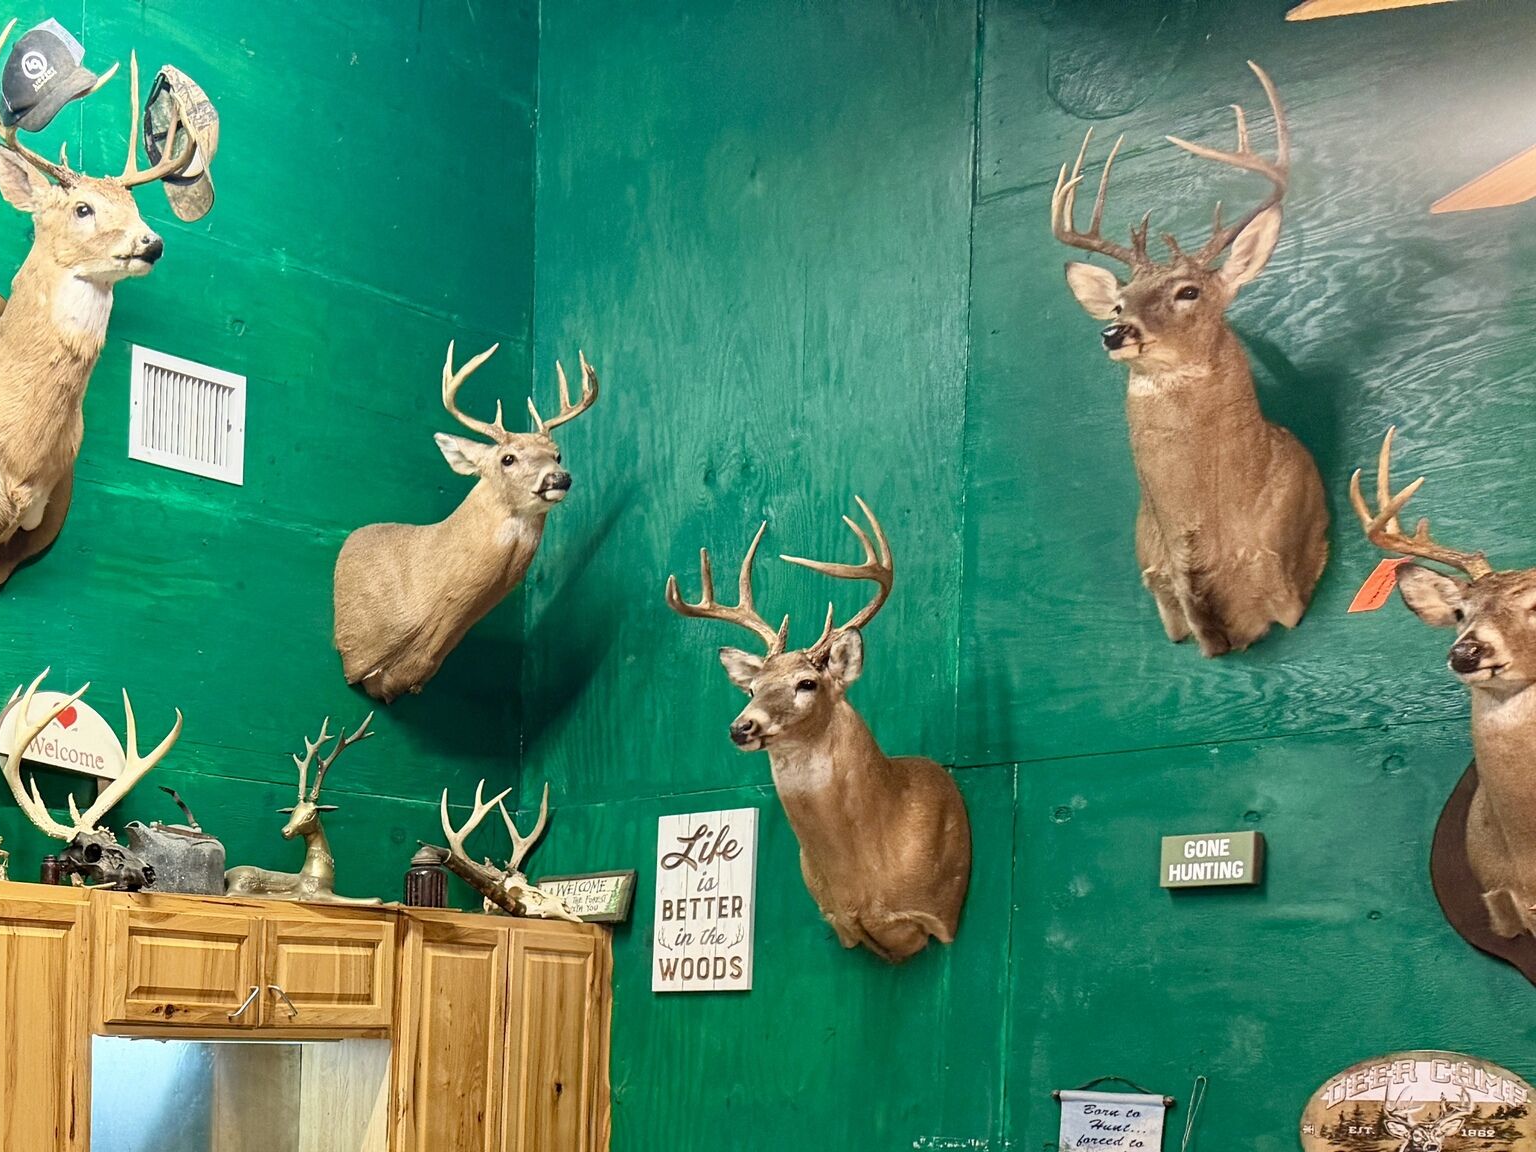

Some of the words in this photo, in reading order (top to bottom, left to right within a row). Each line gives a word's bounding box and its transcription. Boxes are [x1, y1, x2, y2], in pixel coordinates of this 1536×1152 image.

[27, 736, 105, 770] Welcome
[660, 823, 744, 871] Life
[1184, 838, 1230, 858] GONE
[1168, 860, 1244, 882] HUNTING
[696, 871, 719, 892] is
[661, 895, 743, 922] BETTER
[674, 927, 695, 946] in
[699, 926, 727, 945] the
[658, 955, 743, 982] WOODS
[1325, 1059, 1418, 1110] DEER
[1429, 1059, 1530, 1108] CAMP
[1083, 1104, 1120, 1117] Born
[1125, 1109, 1141, 1118] to
[1089, 1119, 1146, 1134] Hunt...
[1348, 1126, 1376, 1135] EST.
[1461, 1128, 1496, 1138] 1862
[1076, 1134, 1125, 1147] forced
[1129, 1139, 1144, 1148] to
